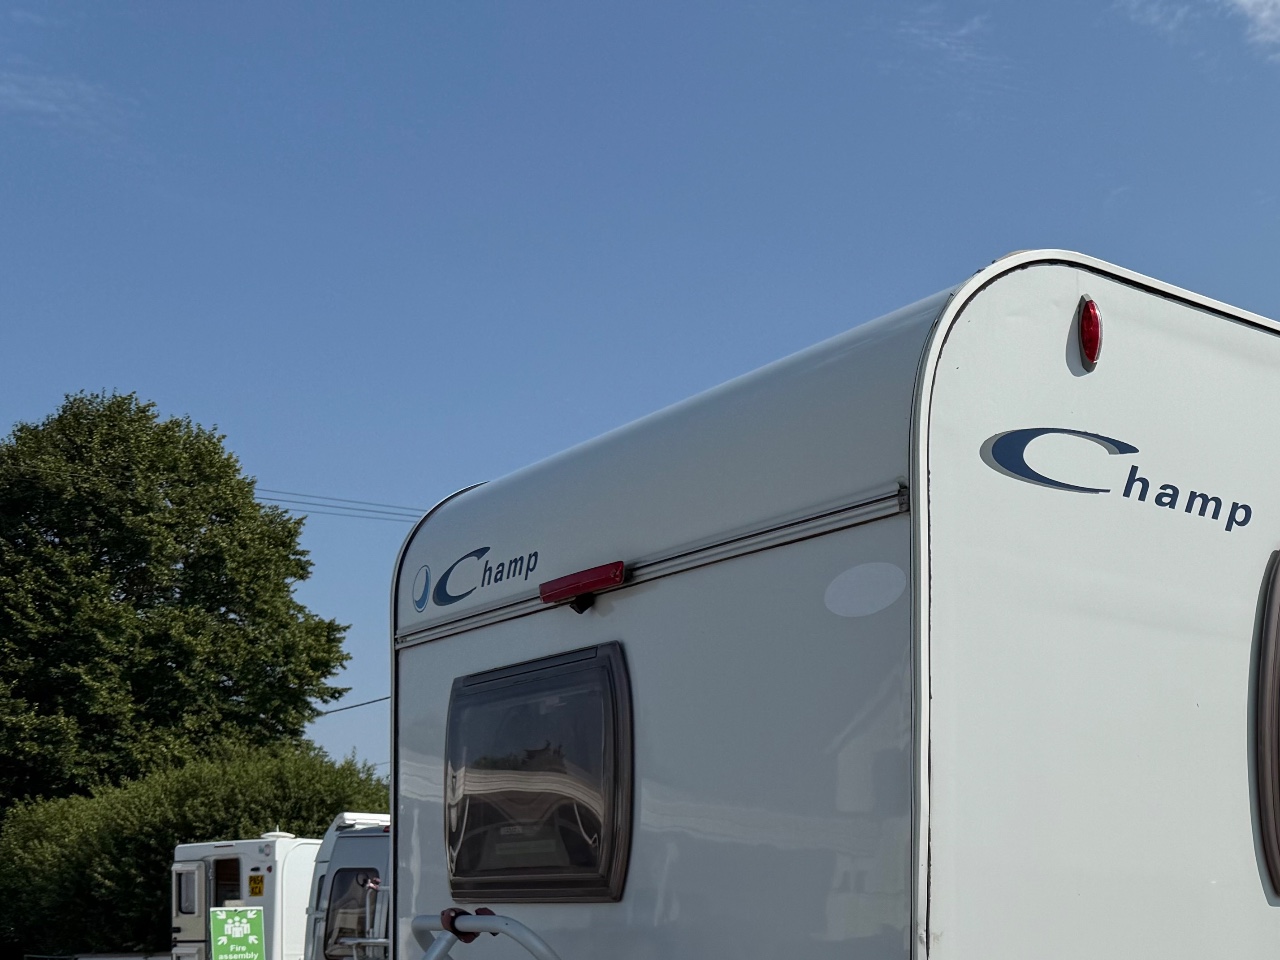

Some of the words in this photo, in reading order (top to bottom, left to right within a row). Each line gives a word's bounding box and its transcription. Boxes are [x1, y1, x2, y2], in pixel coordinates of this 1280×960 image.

[978, 427, 1253, 532] Champ
[432, 546, 539, 607] Champ
[218, 952, 259, 960] assembly
[230, 944, 247, 952] Fire
